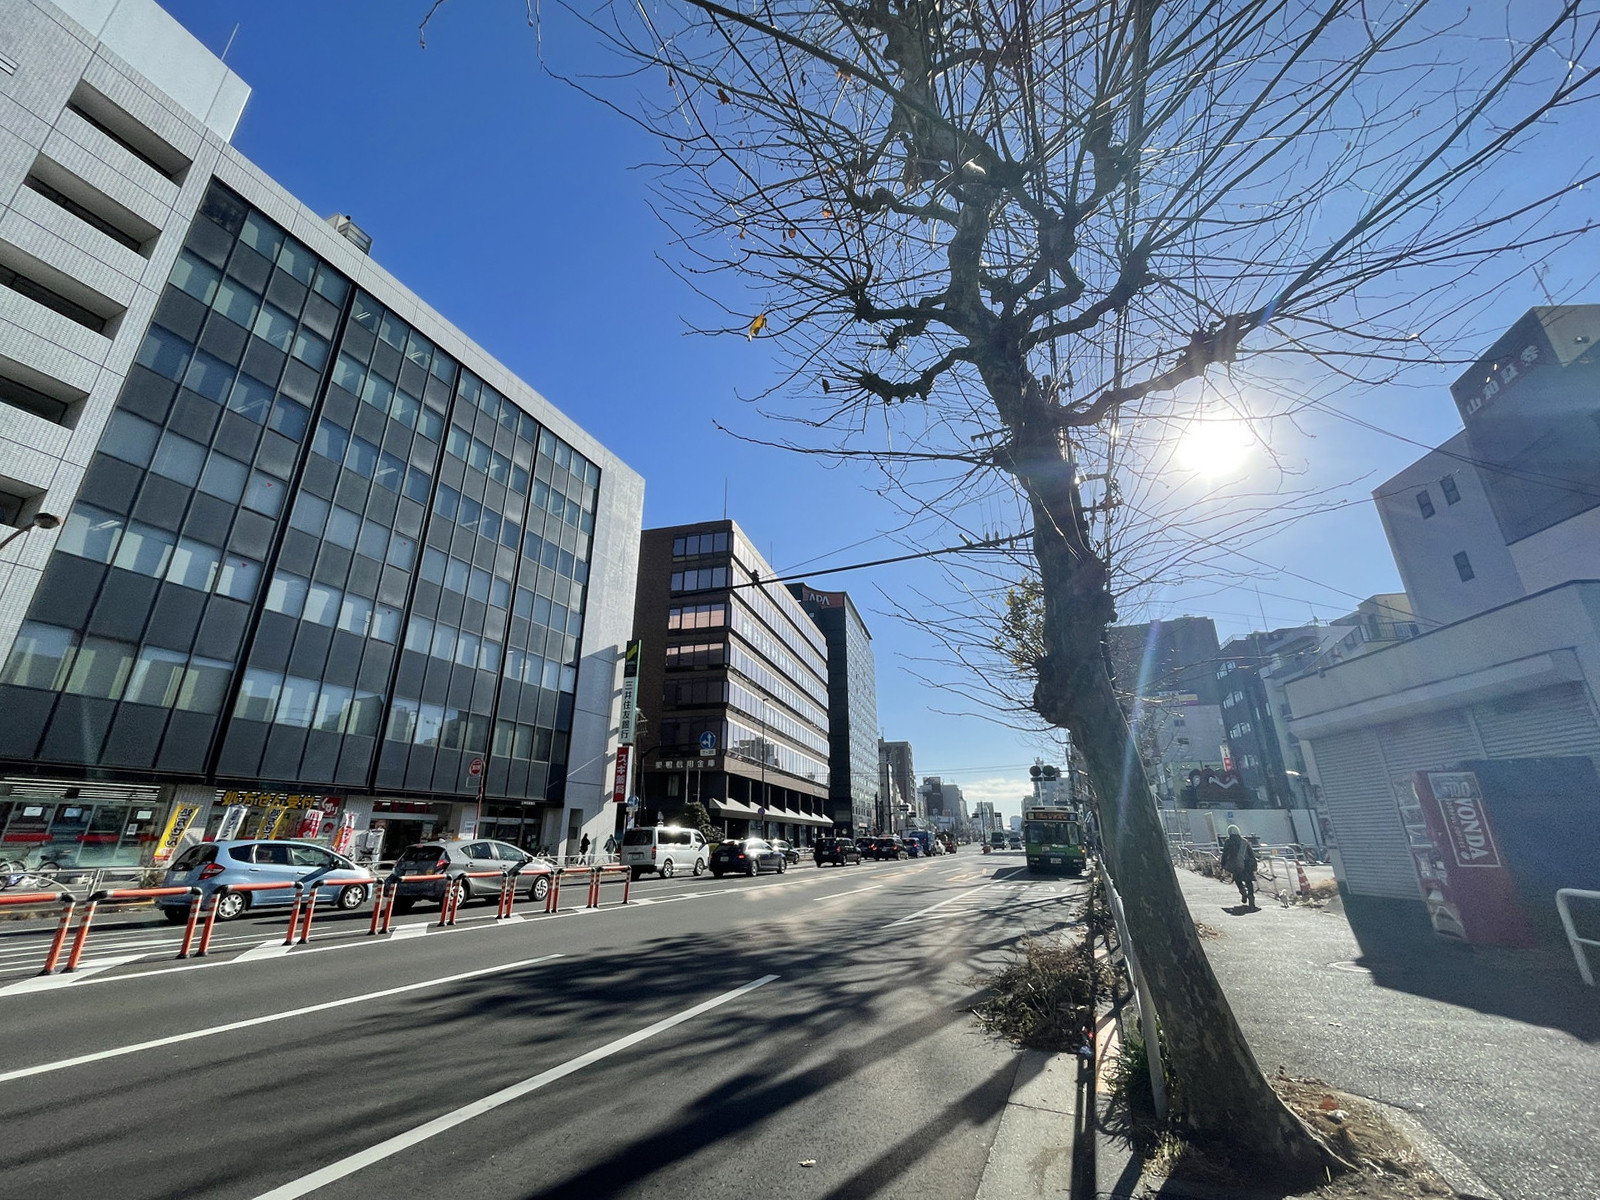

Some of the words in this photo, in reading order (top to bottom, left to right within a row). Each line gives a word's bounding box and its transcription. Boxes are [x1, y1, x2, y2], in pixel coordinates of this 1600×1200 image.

[809, 593, 830, 605] APA
[620, 681, 633, 739] 三井住友銀行
[221, 790, 315, 810] 処方せん受付
